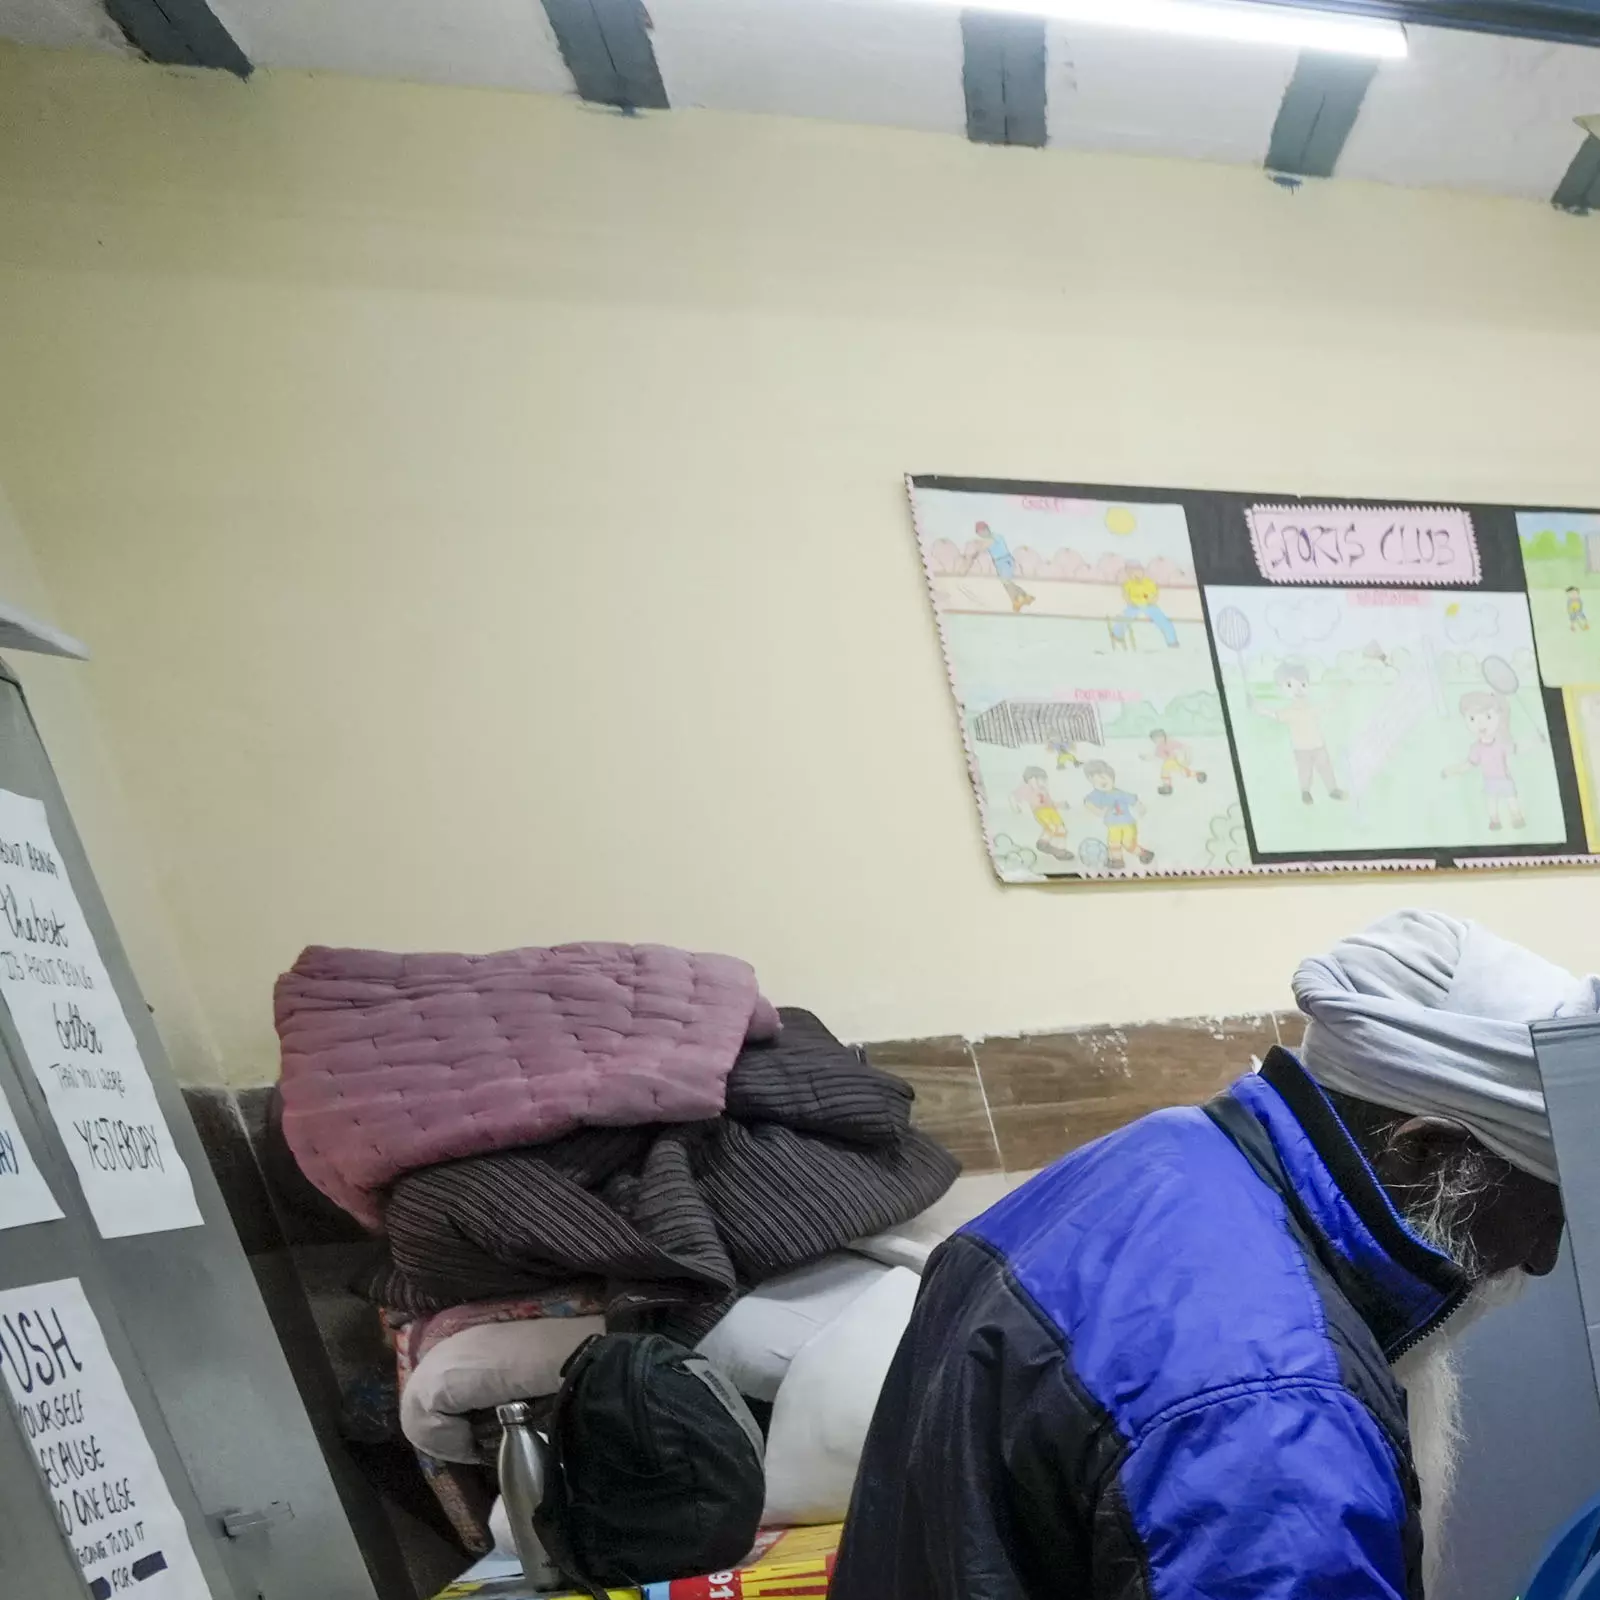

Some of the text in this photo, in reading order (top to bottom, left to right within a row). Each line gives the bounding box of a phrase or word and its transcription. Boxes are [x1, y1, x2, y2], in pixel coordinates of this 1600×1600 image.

[1380, 522, 1455, 566] CLUB
[72, 1117, 166, 1174] YESTERDAY
[0, 1307, 83, 1394] USH
[19, 1388, 85, 1439] OURSELF
[39, 1434, 105, 1489] ECAUSE
[72, 1489, 104, 1527] ONE
[103, 1477, 136, 1515] ELSE
[106, 1531, 121, 1556] TO
[117, 1528, 135, 1552] DO
[134, 1520, 145, 1542] IT
[111, 1566, 134, 1593] FOR
